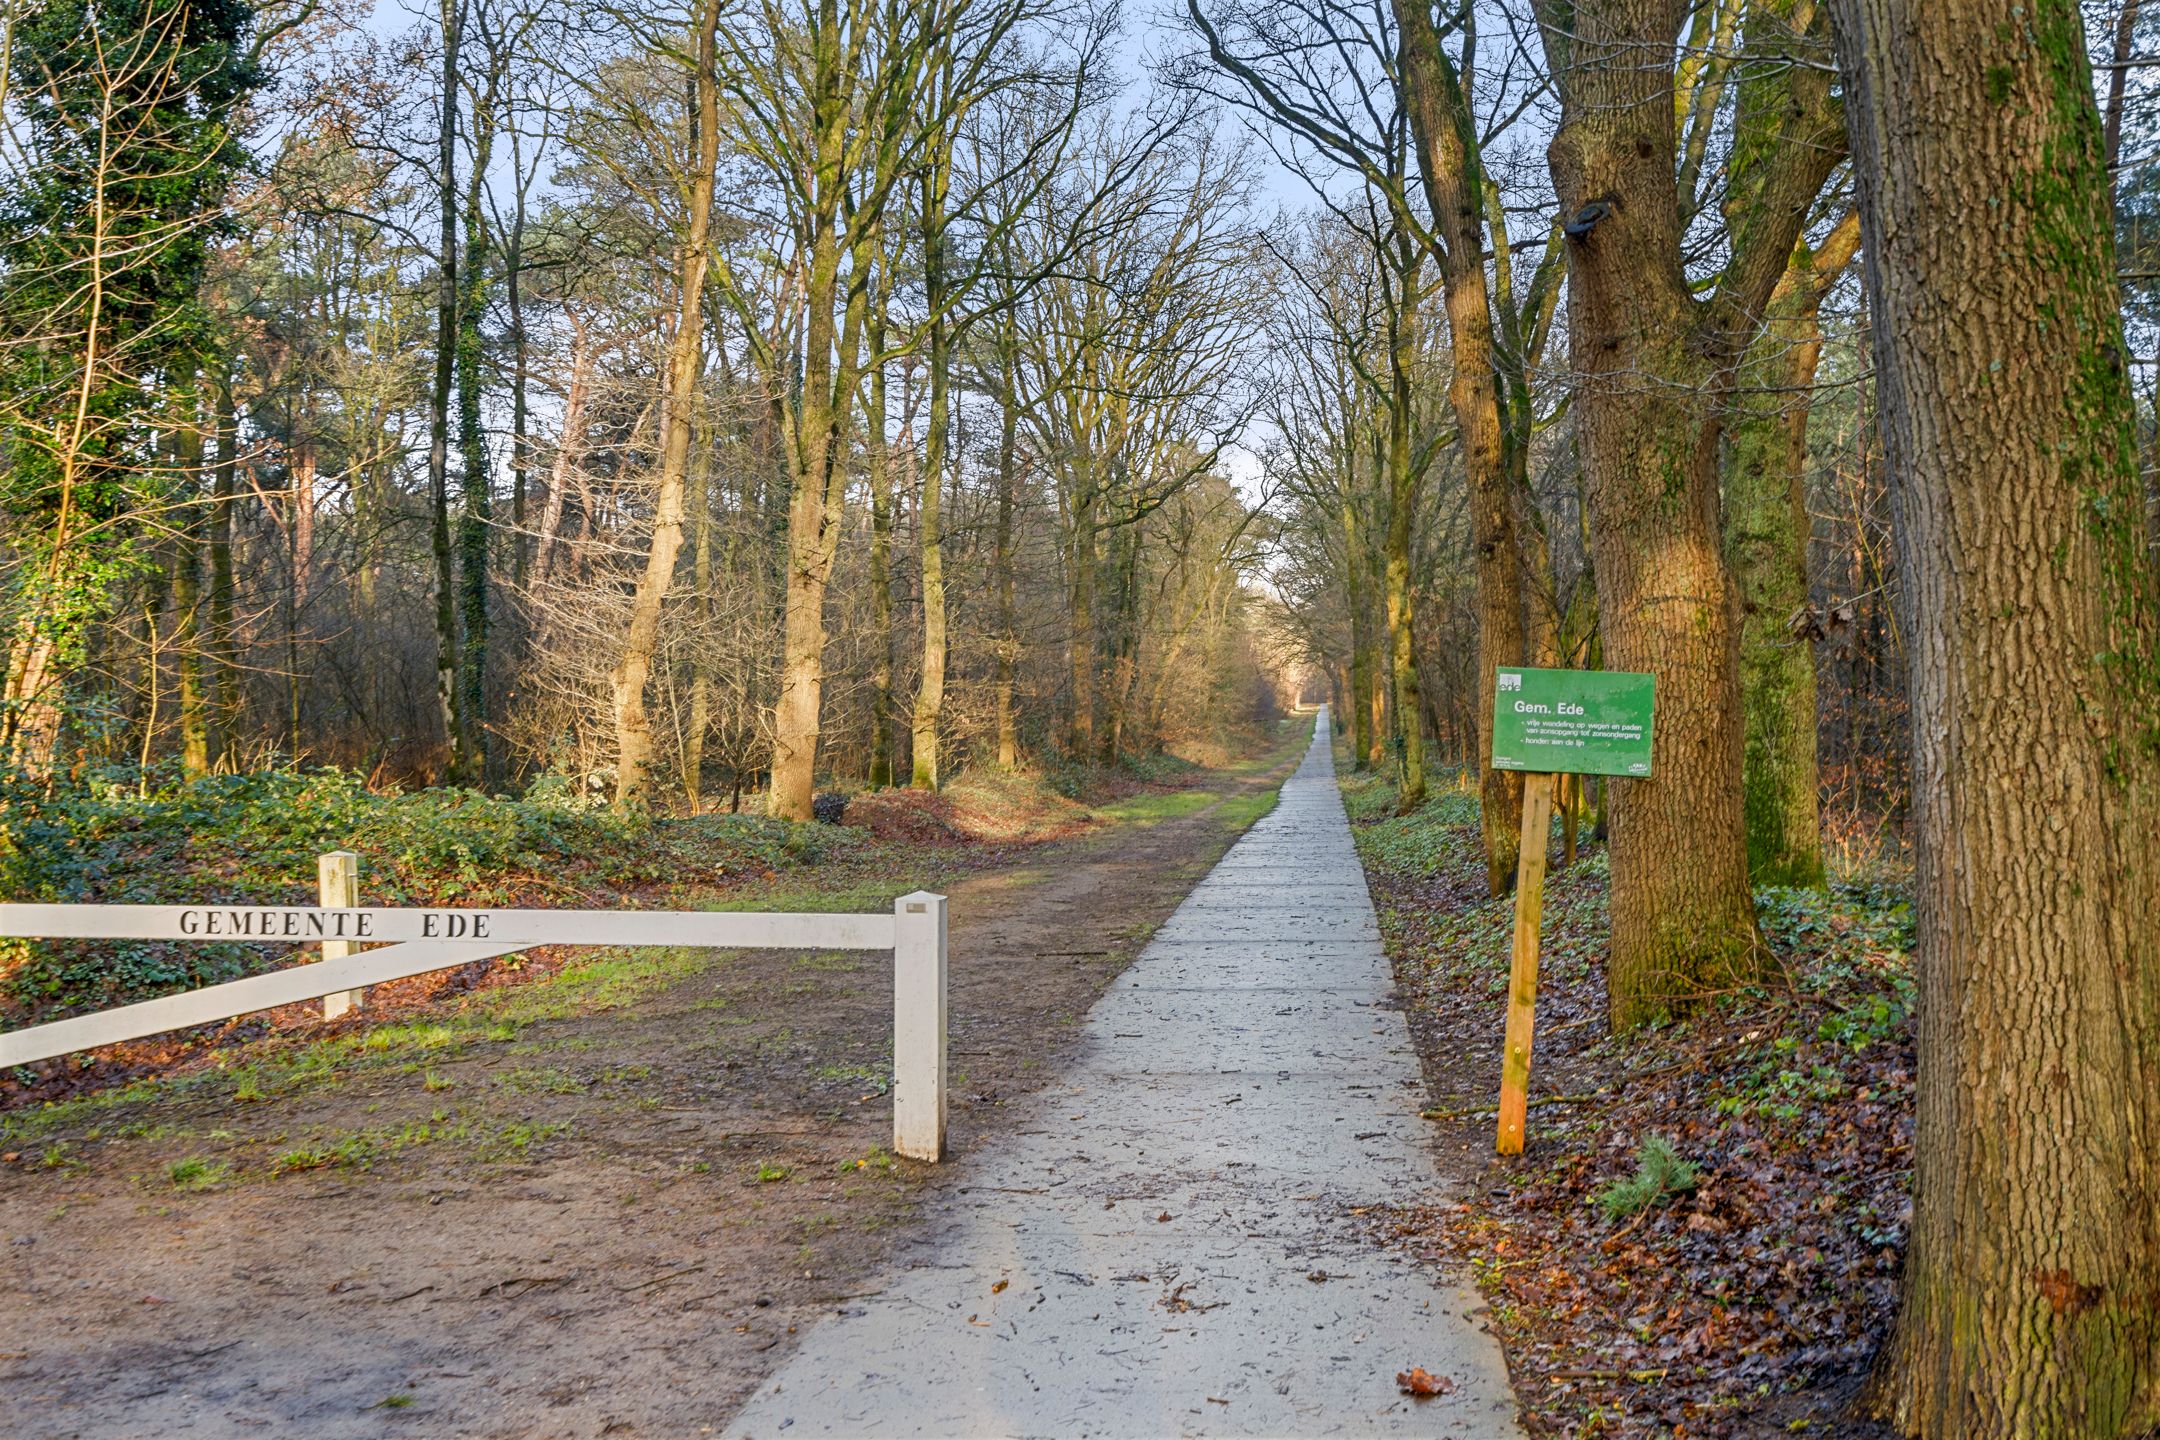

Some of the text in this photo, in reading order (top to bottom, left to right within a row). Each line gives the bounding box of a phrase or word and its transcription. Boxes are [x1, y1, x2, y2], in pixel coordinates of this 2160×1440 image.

[1514, 701, 1584, 715] Gem. Ede
[1527, 719, 1540, 727] vrije
[1543, 721, 1574, 729] wandeling
[1540, 728, 1578, 737] zonsopgang
[1592, 731, 1641, 739] zonsondergang
[1576, 739, 1584, 747] lijn
[180, 910, 490, 938] GEMEENTE EDE
